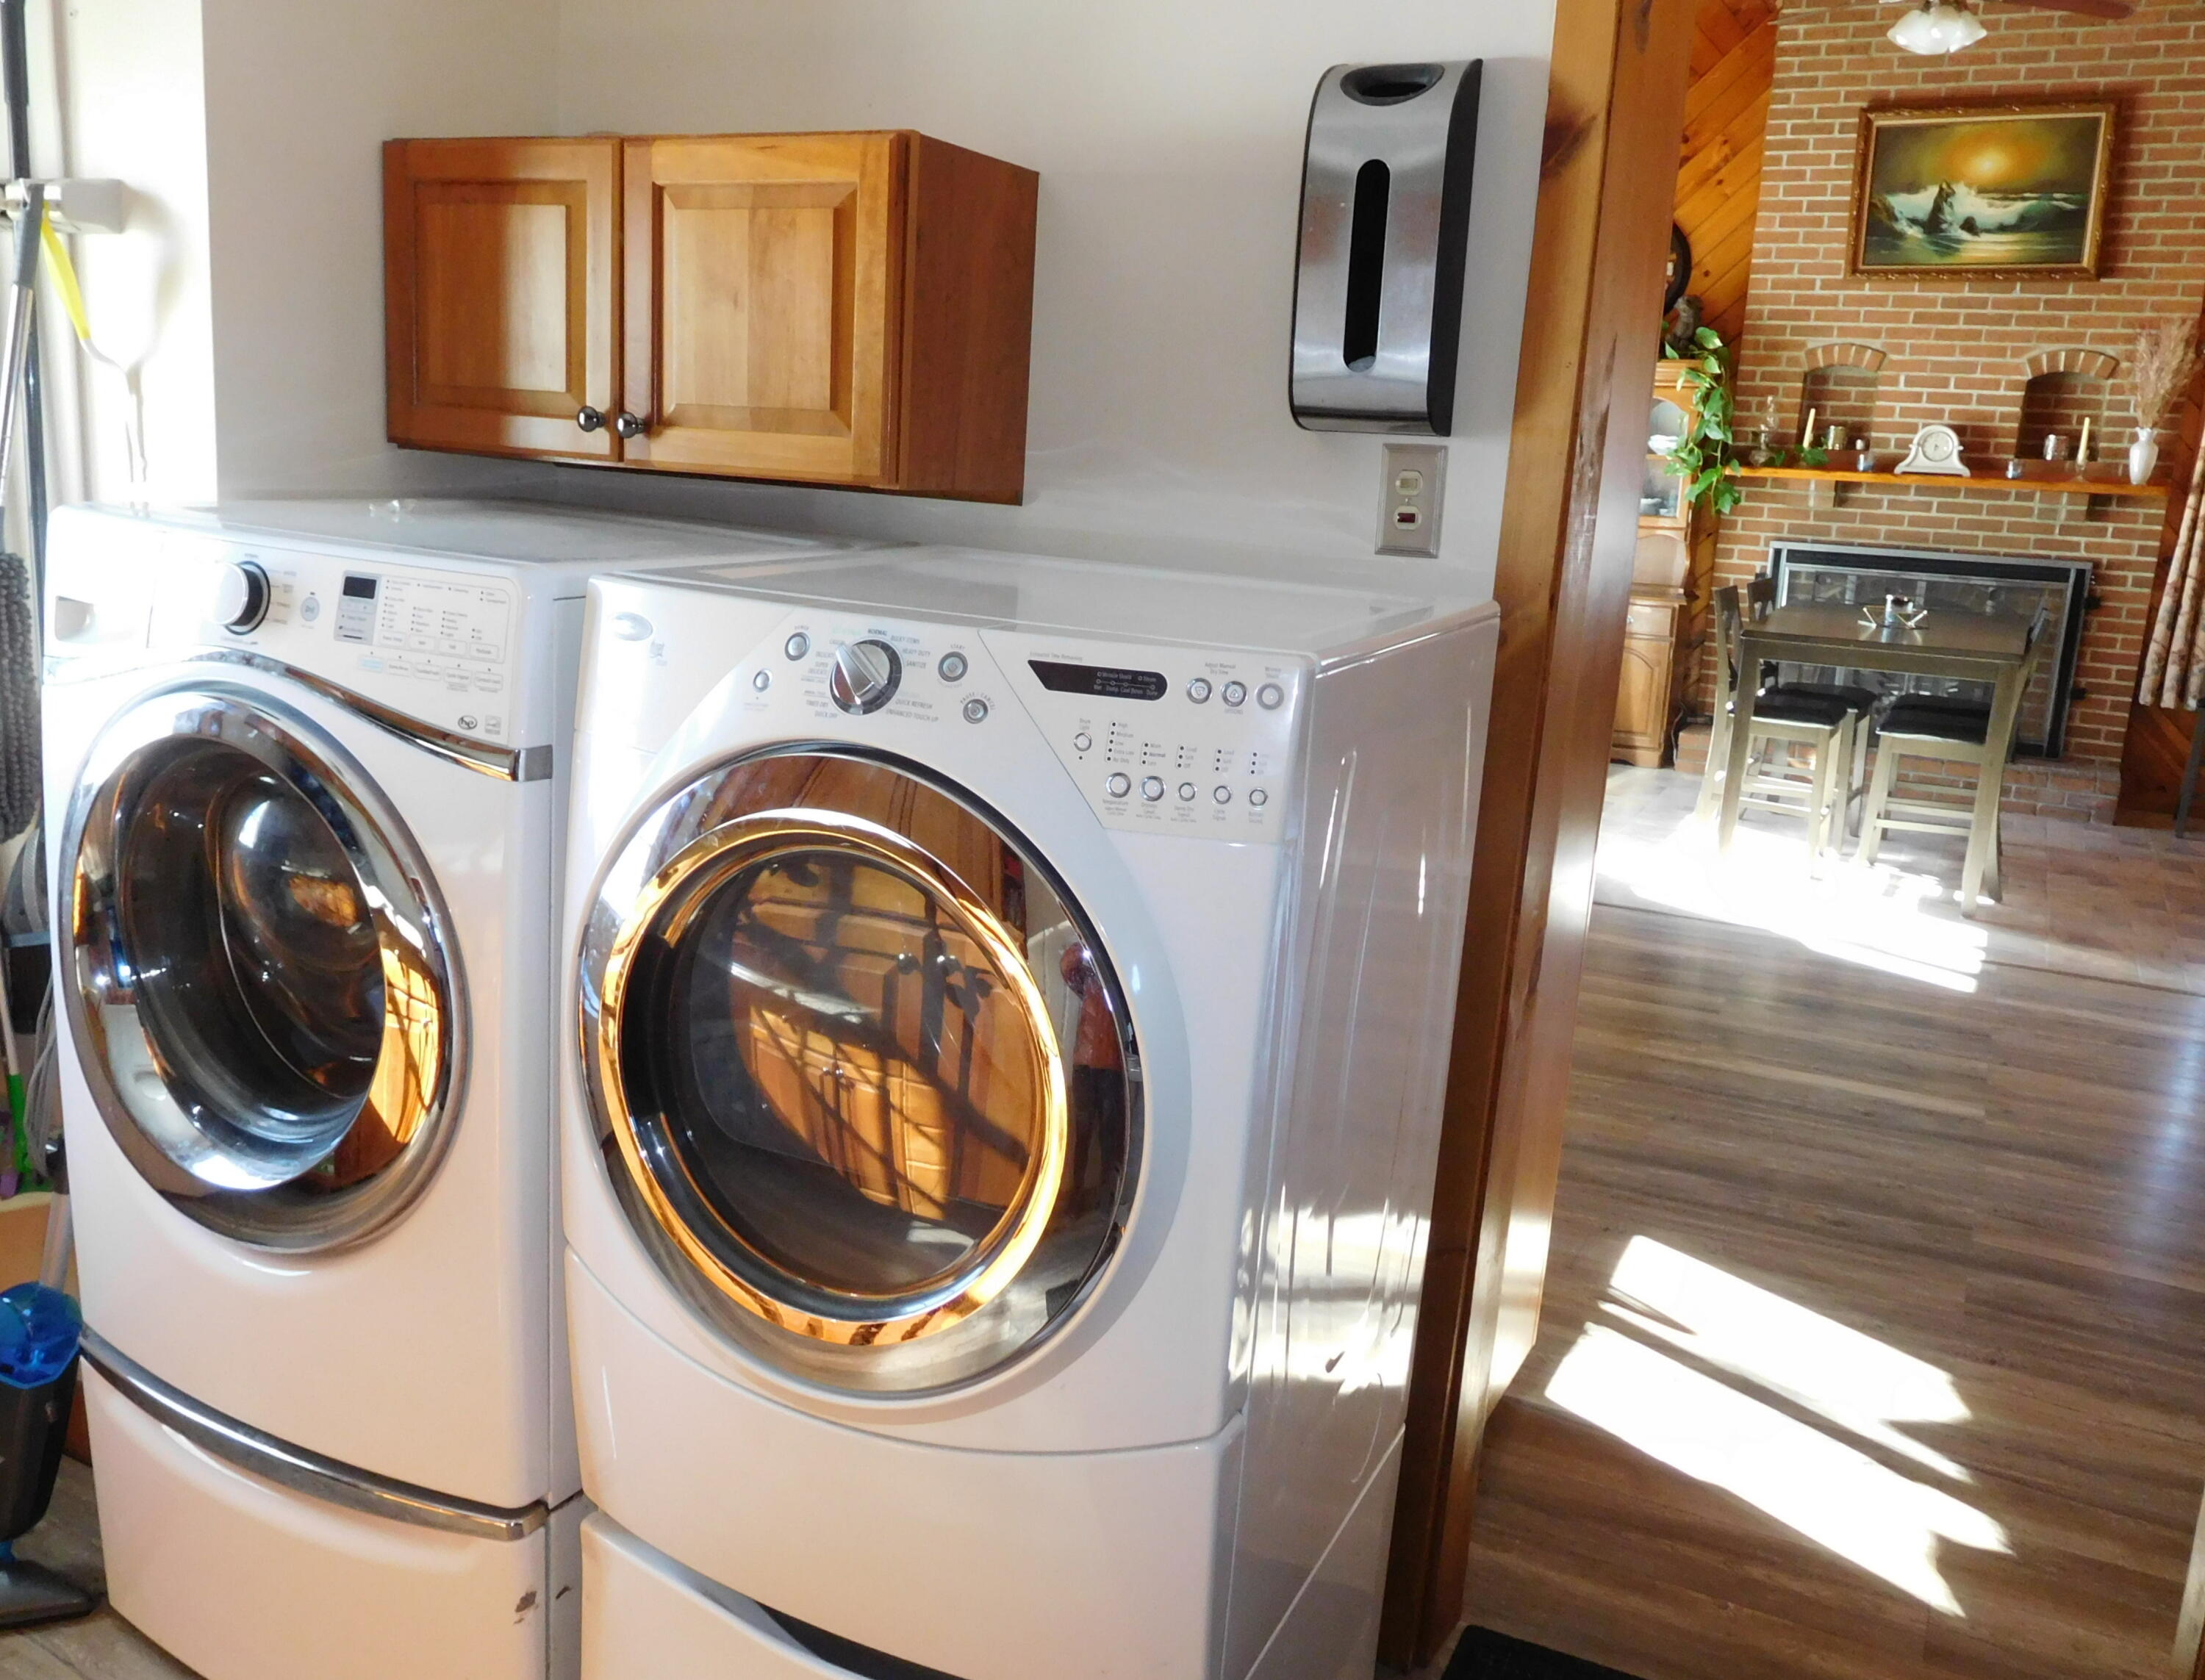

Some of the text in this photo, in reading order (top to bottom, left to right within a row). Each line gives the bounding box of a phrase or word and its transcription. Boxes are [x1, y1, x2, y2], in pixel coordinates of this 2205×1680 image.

[867, 628, 888, 636] NORMAL
[906, 660, 926, 669] SANITIZE
[911, 700, 933, 709] REFRESH
[886, 708, 913, 718] ENHANCED
[913, 712, 931, 721] TOUCH
